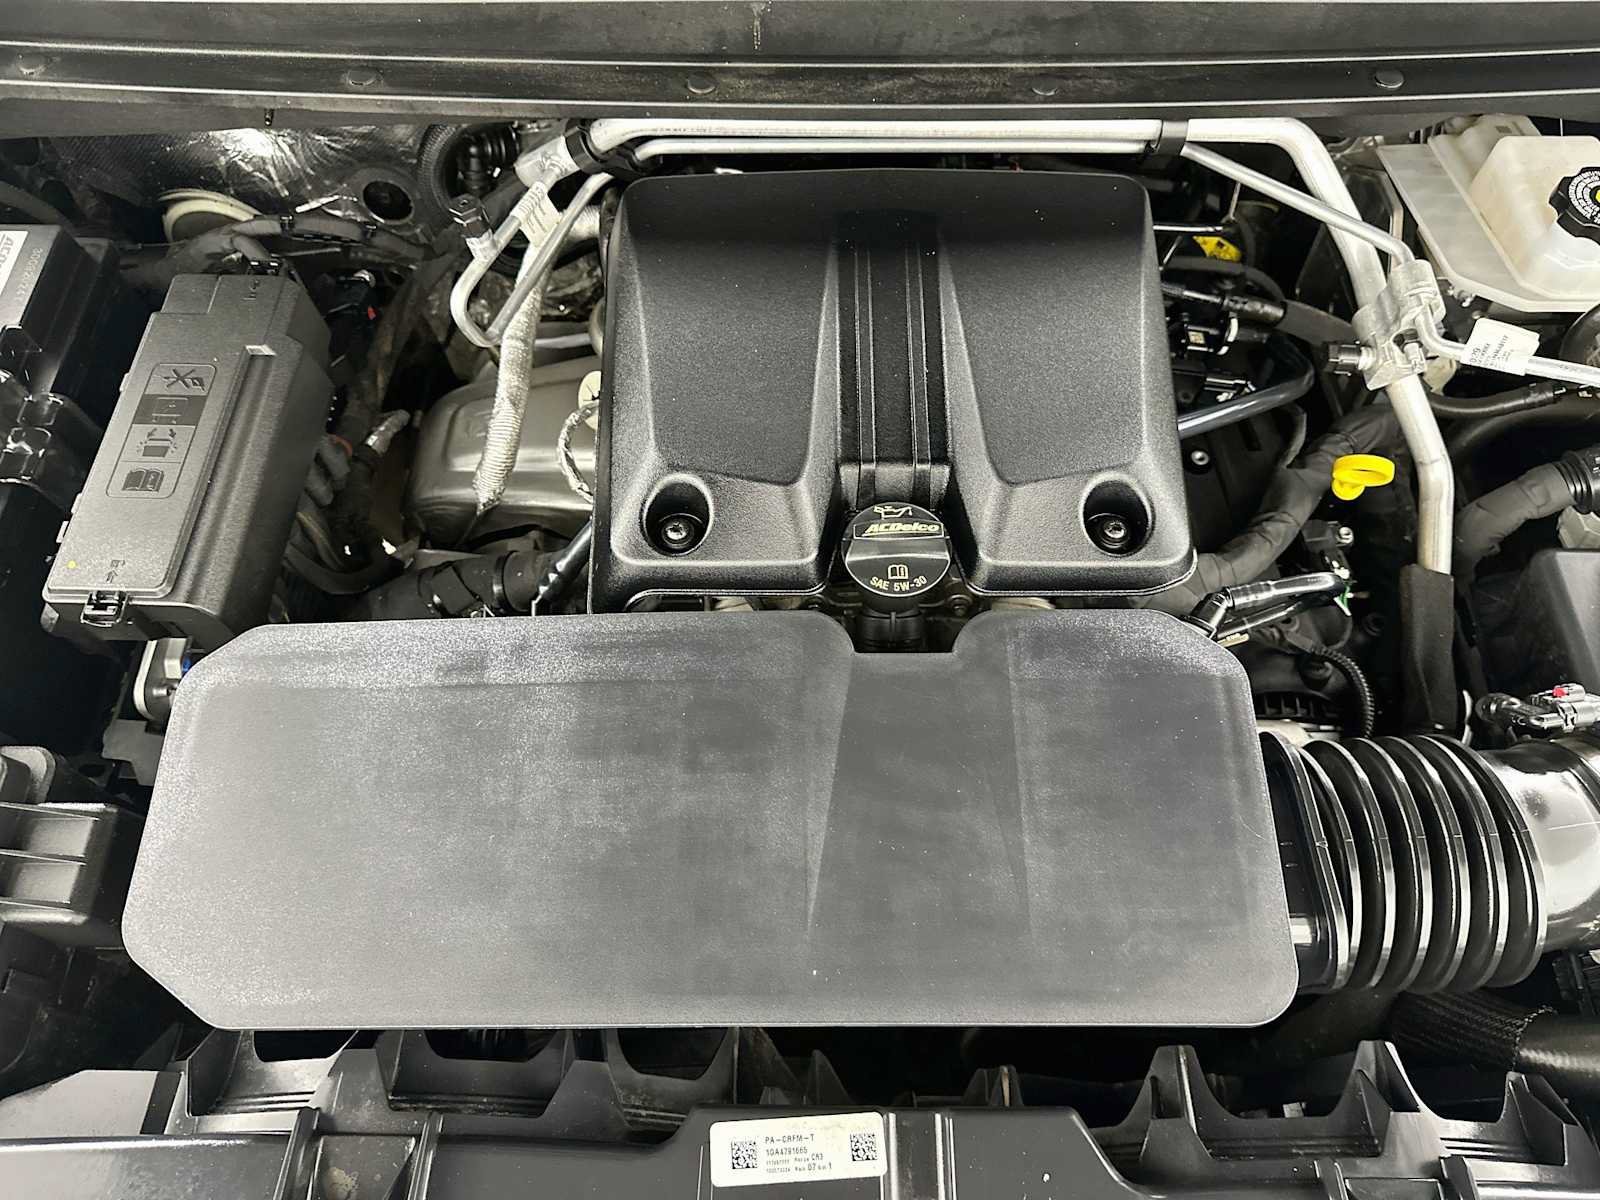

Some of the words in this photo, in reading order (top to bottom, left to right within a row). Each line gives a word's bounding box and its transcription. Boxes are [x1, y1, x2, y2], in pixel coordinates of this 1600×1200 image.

[863, 522, 940, 536] ACDelco
[870, 577, 890, 590] SAE
[893, 576, 928, 591] 5W-30
